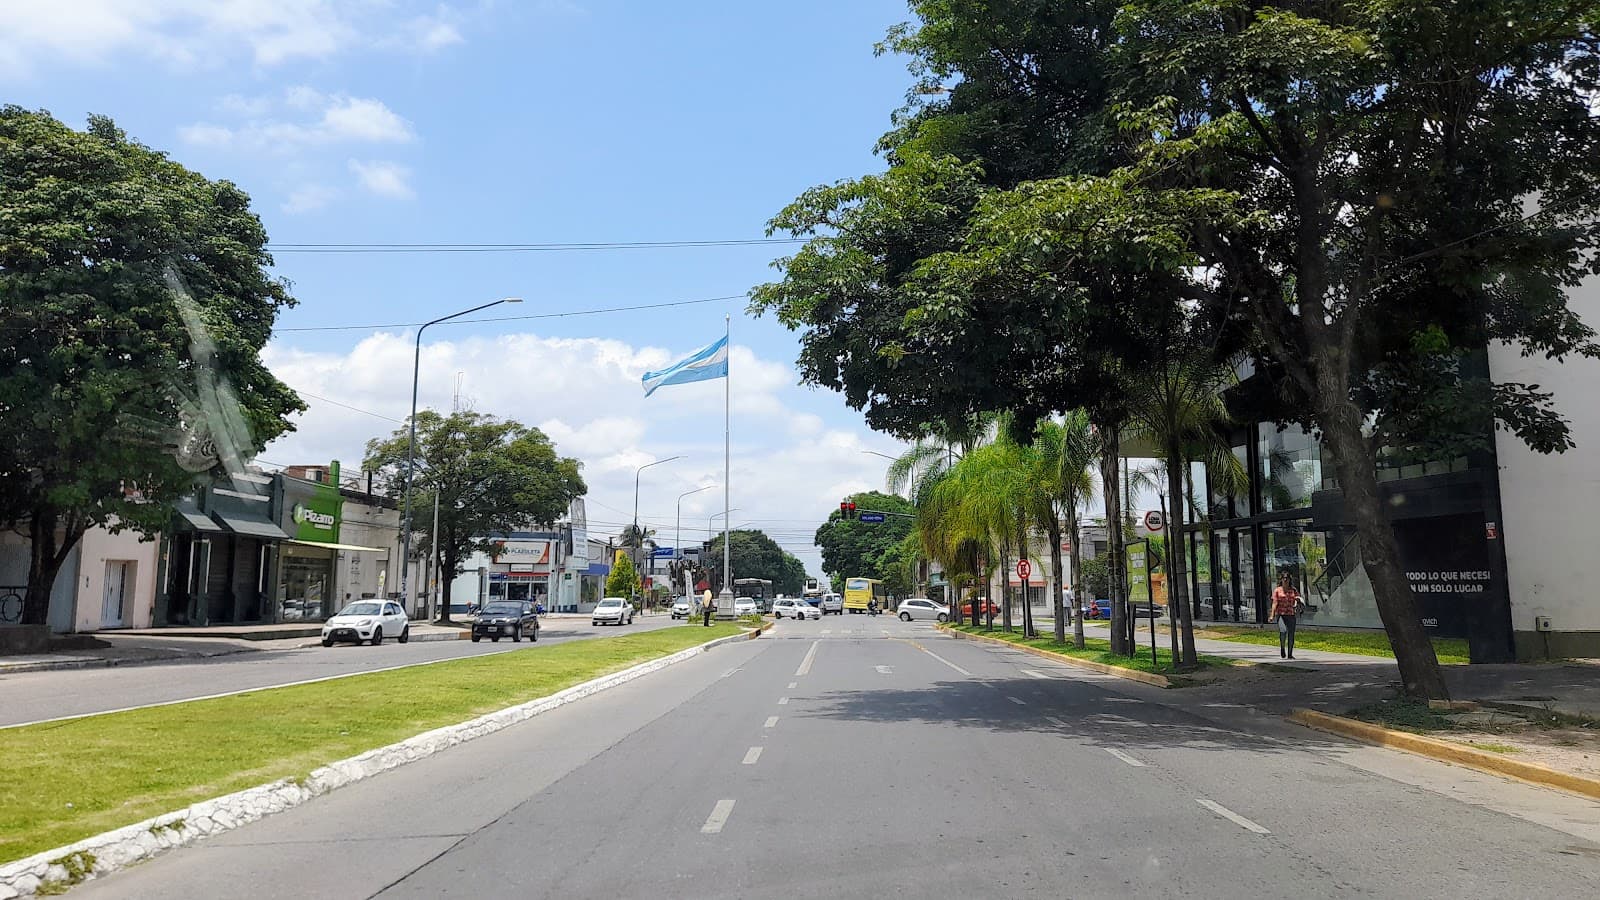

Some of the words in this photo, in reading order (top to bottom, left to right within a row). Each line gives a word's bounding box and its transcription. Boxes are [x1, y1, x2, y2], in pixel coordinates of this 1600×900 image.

[1428, 572, 1439, 580] LO
[1441, 572, 1458, 581] QUE
[1460, 571, 1491, 580] NECESI
[1418, 584, 1429, 592] UN
[1430, 584, 1452, 592] SOLO
[1454, 584, 1483, 592] LUGAR
